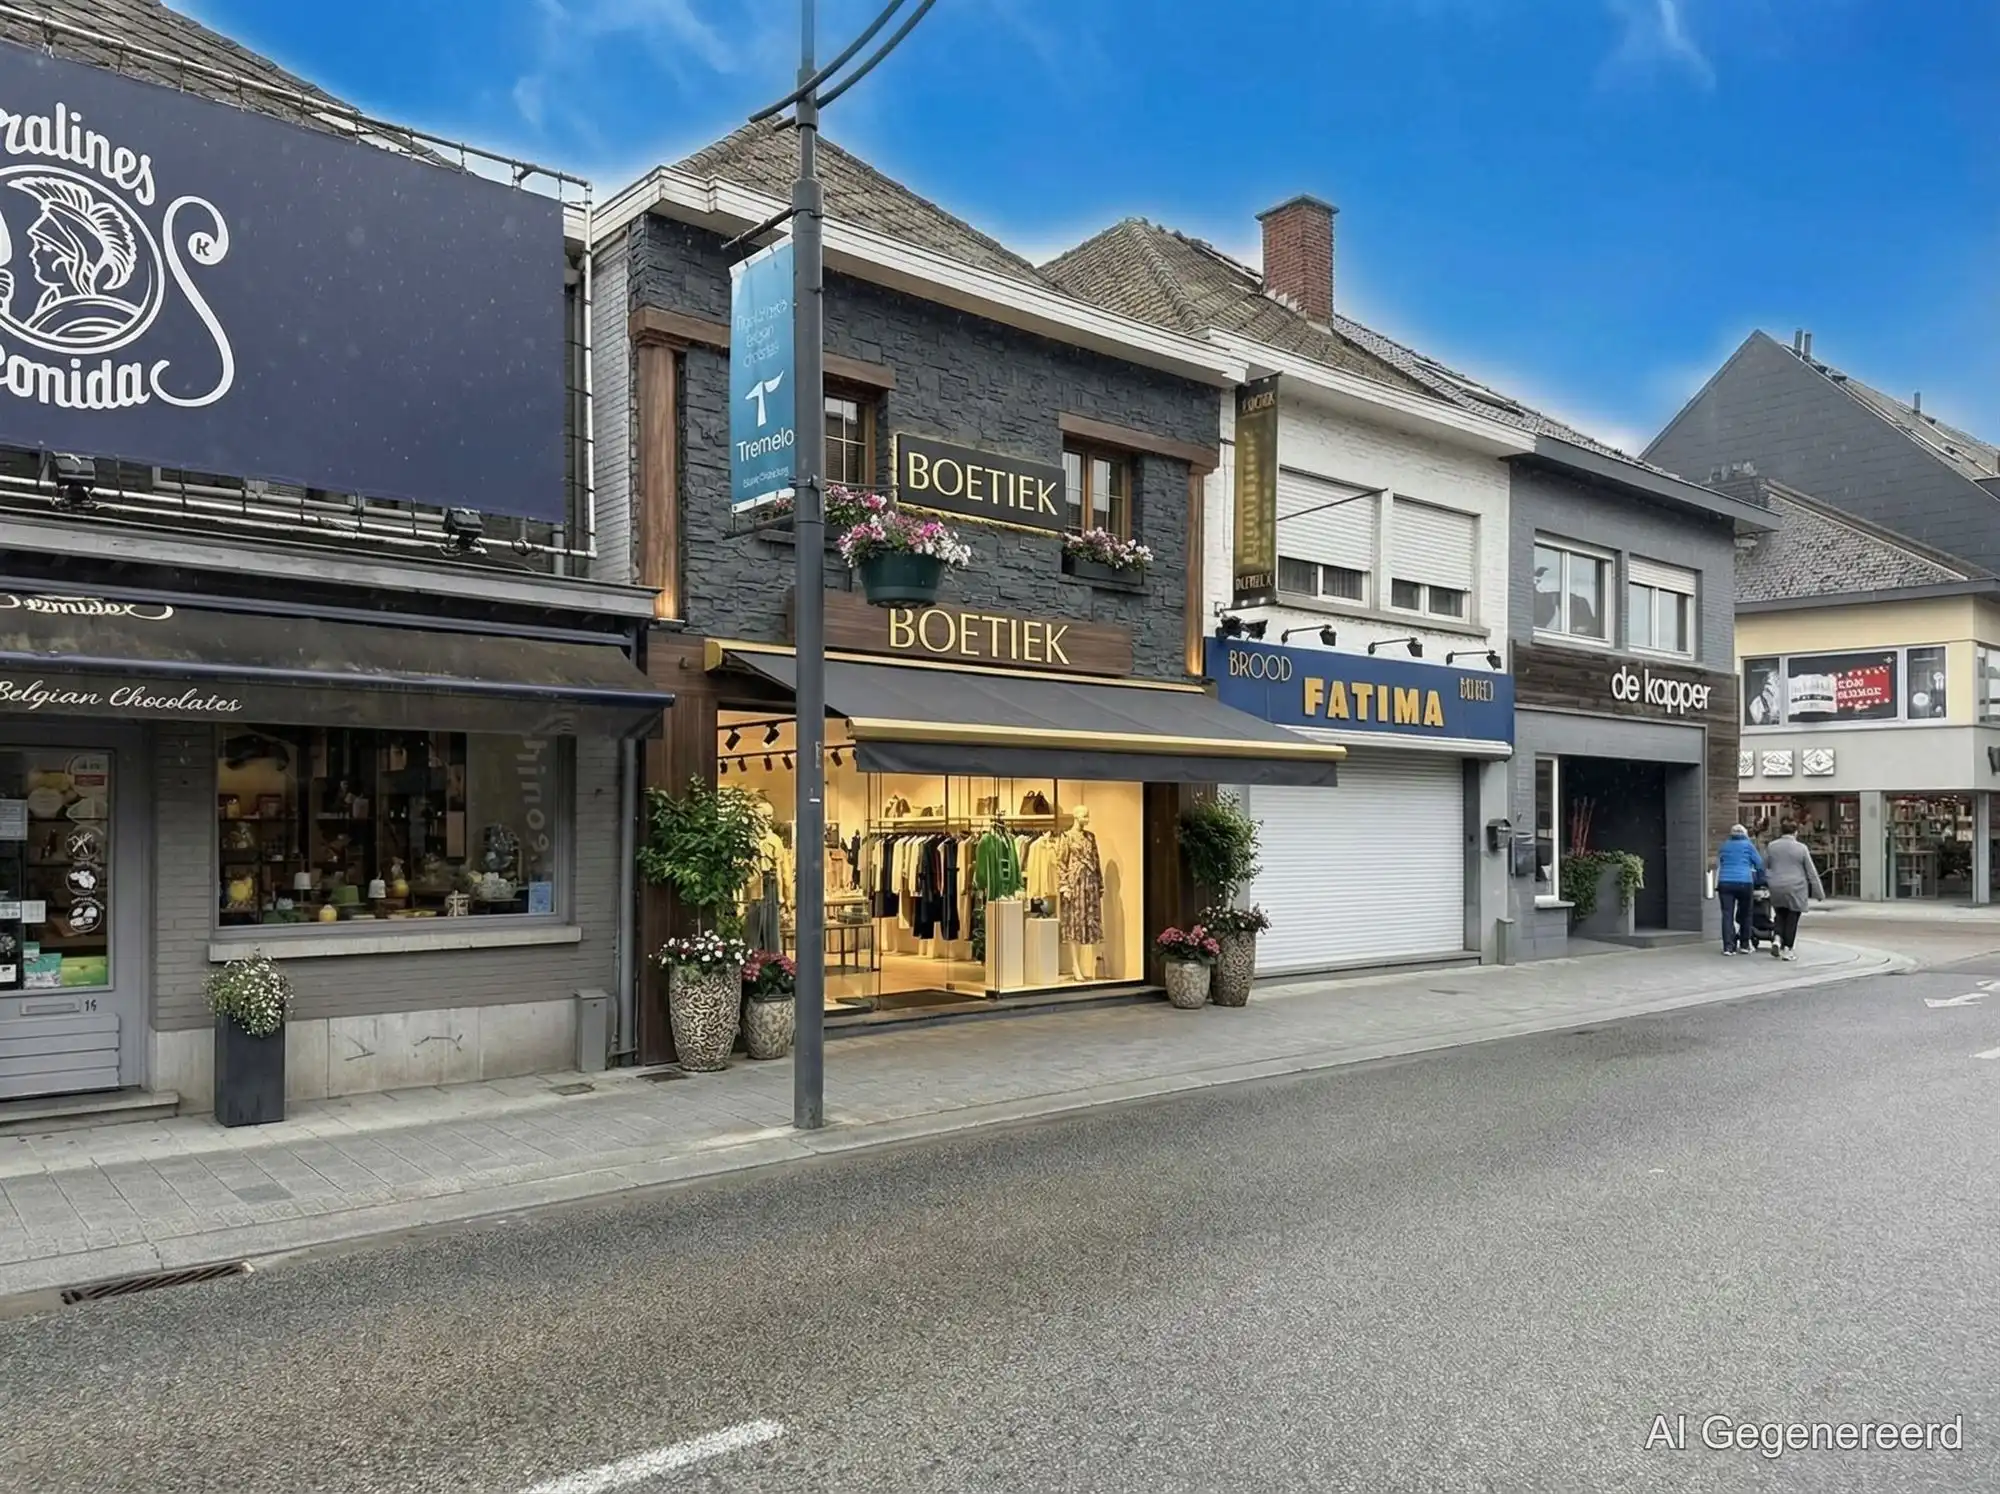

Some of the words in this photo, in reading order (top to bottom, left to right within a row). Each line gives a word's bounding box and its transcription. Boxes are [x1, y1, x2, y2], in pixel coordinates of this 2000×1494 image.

[0, 102, 155, 206] ralines
[735, 426, 795, 463] Tremelo
[907, 451, 1059, 516] BOETIEK
[889, 607, 1071, 666] BOETIEK
[1228, 649, 1293, 682] BROOD
[1611, 665, 1640, 702] de
[1644, 668, 1712, 715] kapper
[0, 679, 104, 711] Belgian
[109, 685, 243, 713] Chocolates
[1303, 676, 1445, 728] FATIMA
